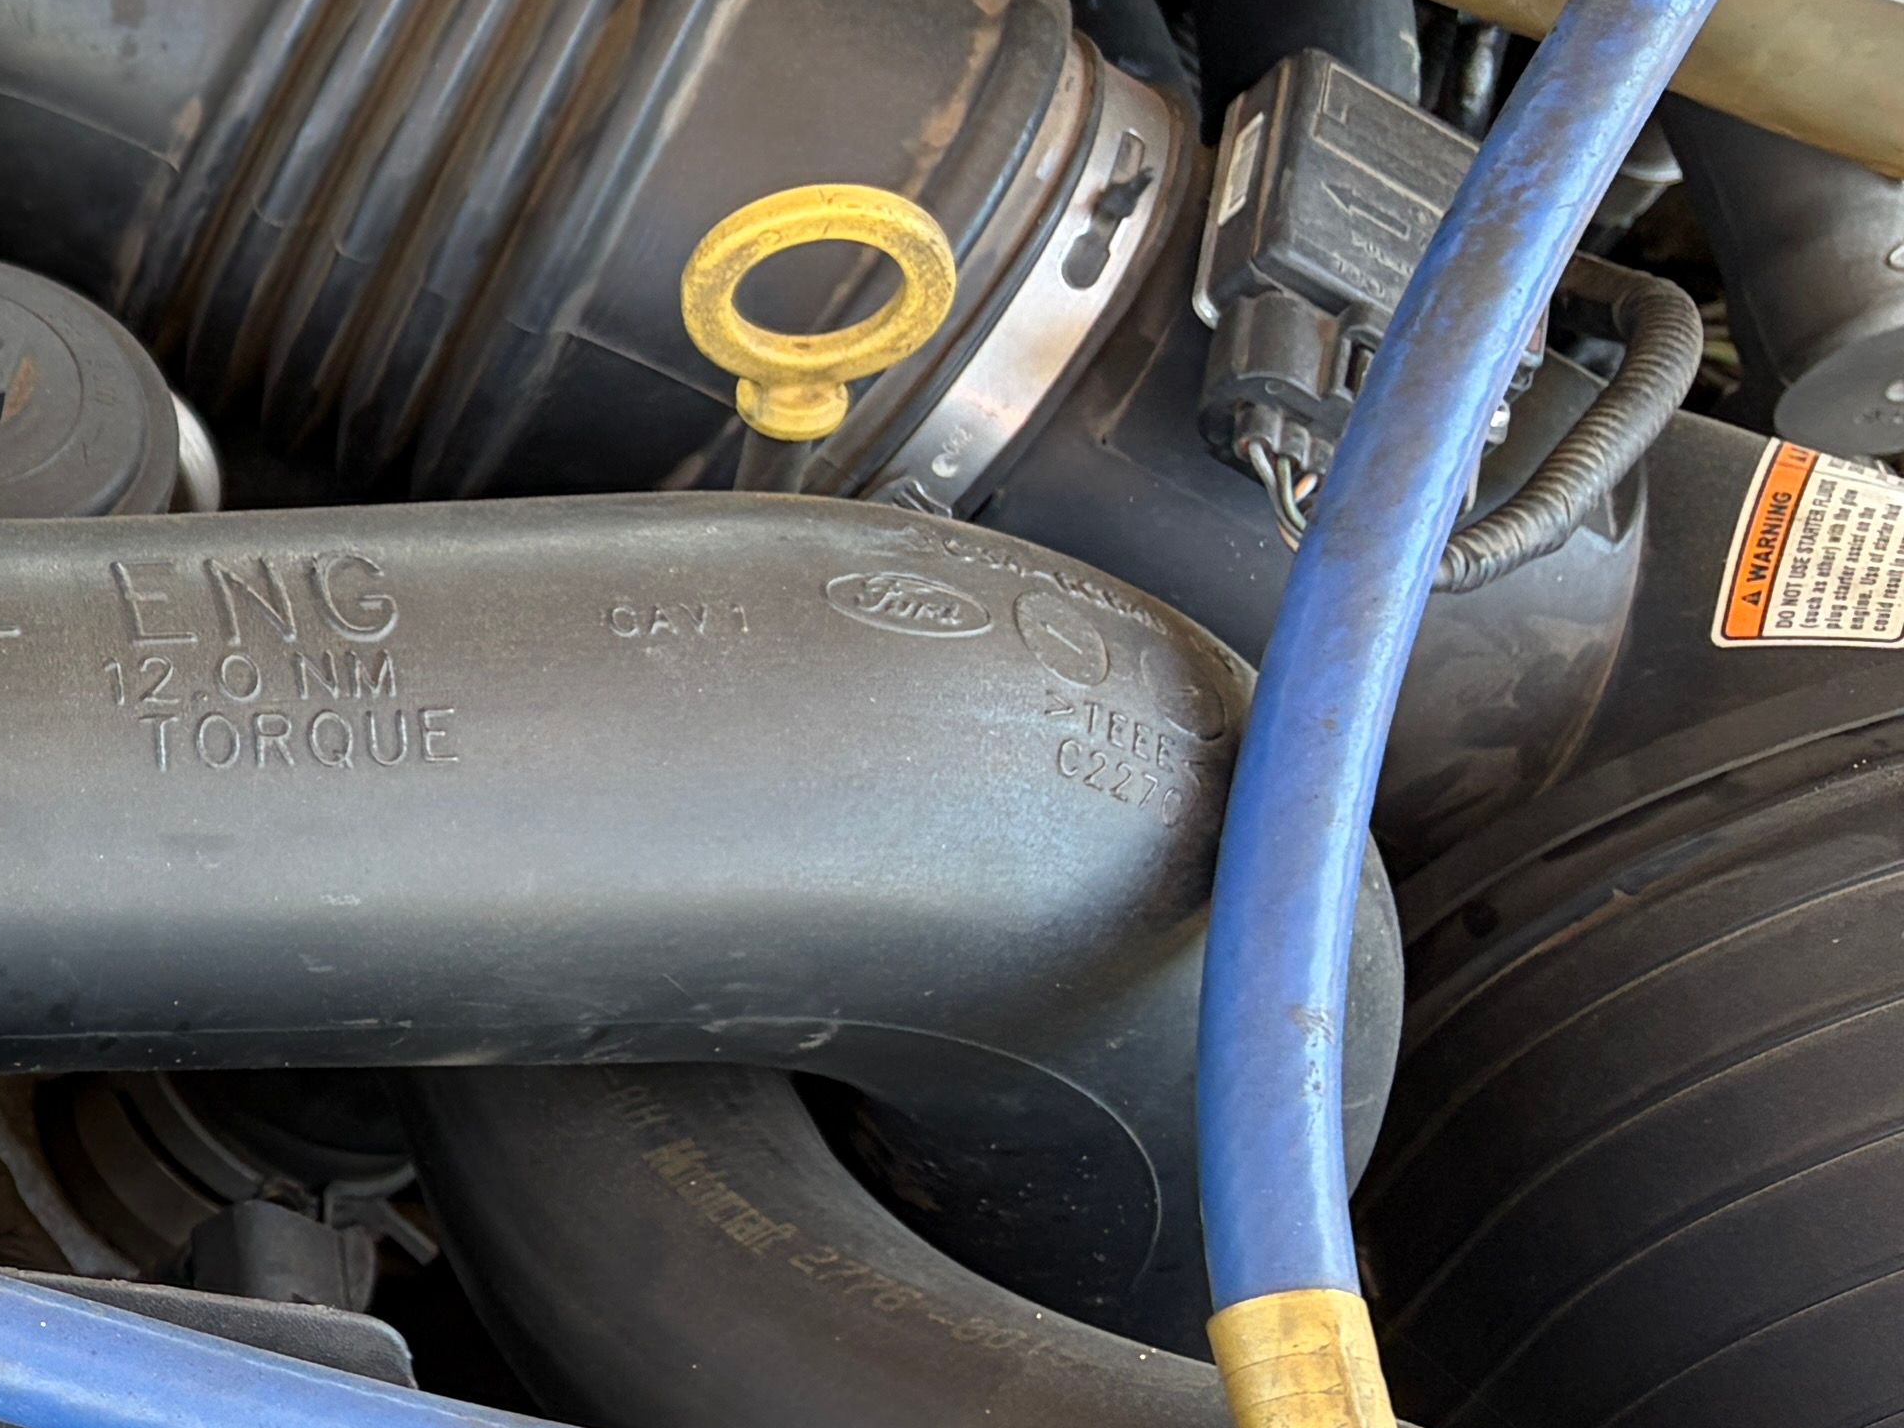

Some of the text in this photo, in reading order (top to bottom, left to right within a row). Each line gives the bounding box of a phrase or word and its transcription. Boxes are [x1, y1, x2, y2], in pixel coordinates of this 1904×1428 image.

[1832, 506, 1852, 522] the
[1858, 506, 1877, 520] the
[1746, 490, 1792, 583] WARNING
[1795, 508, 1827, 555] STARTER
[1827, 522, 1847, 544] with
[1873, 521, 1896, 553] starter
[1815, 545, 1843, 579] ether)
[1845, 532, 1867, 564] assist
[1869, 551, 1886, 565] of
[1788, 555, 1812, 580] USE
[1833, 564, 1856, 602] starter
[1858, 564, 1881, 586] Use
[110, 553, 400, 644] ENG
[853, 572, 964, 627] Ford
[1780, 580, 1803, 607] NOT
[1812, 579, 1829, 590] as
[1882, 568, 1904, 601] result
[1774, 609, 1796, 629] DO
[1798, 590, 1824, 630] (such
[1824, 603, 1849, 631] plug
[1849, 588, 1874, 631] engine.
[1872, 600, 1894, 633] could
[102, 648, 398, 706] 12.0 NM
[138, 708, 460, 772] TORQUE
